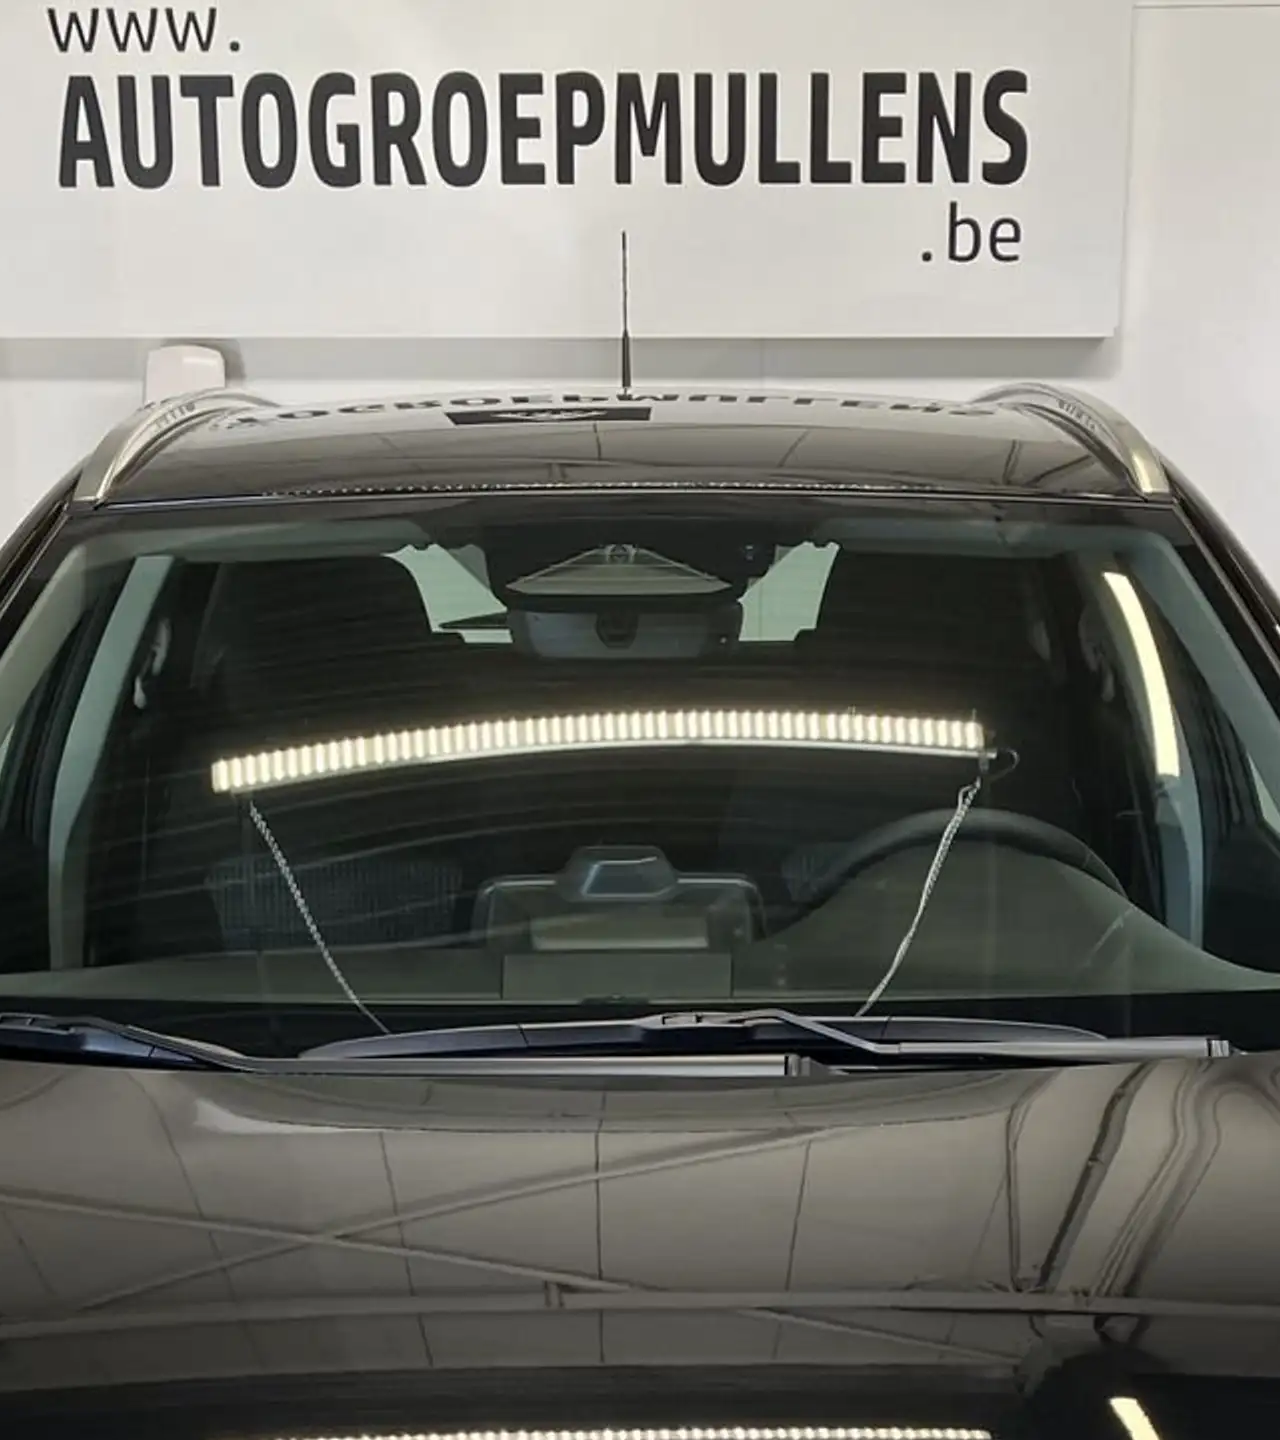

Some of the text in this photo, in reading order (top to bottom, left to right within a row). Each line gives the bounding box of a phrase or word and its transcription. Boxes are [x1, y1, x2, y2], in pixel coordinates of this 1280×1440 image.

[48, 7, 240, 53] www.
[58, 70, 1028, 189] AUTOGROEPMULLENS
[921, 201, 1022, 263] .be
